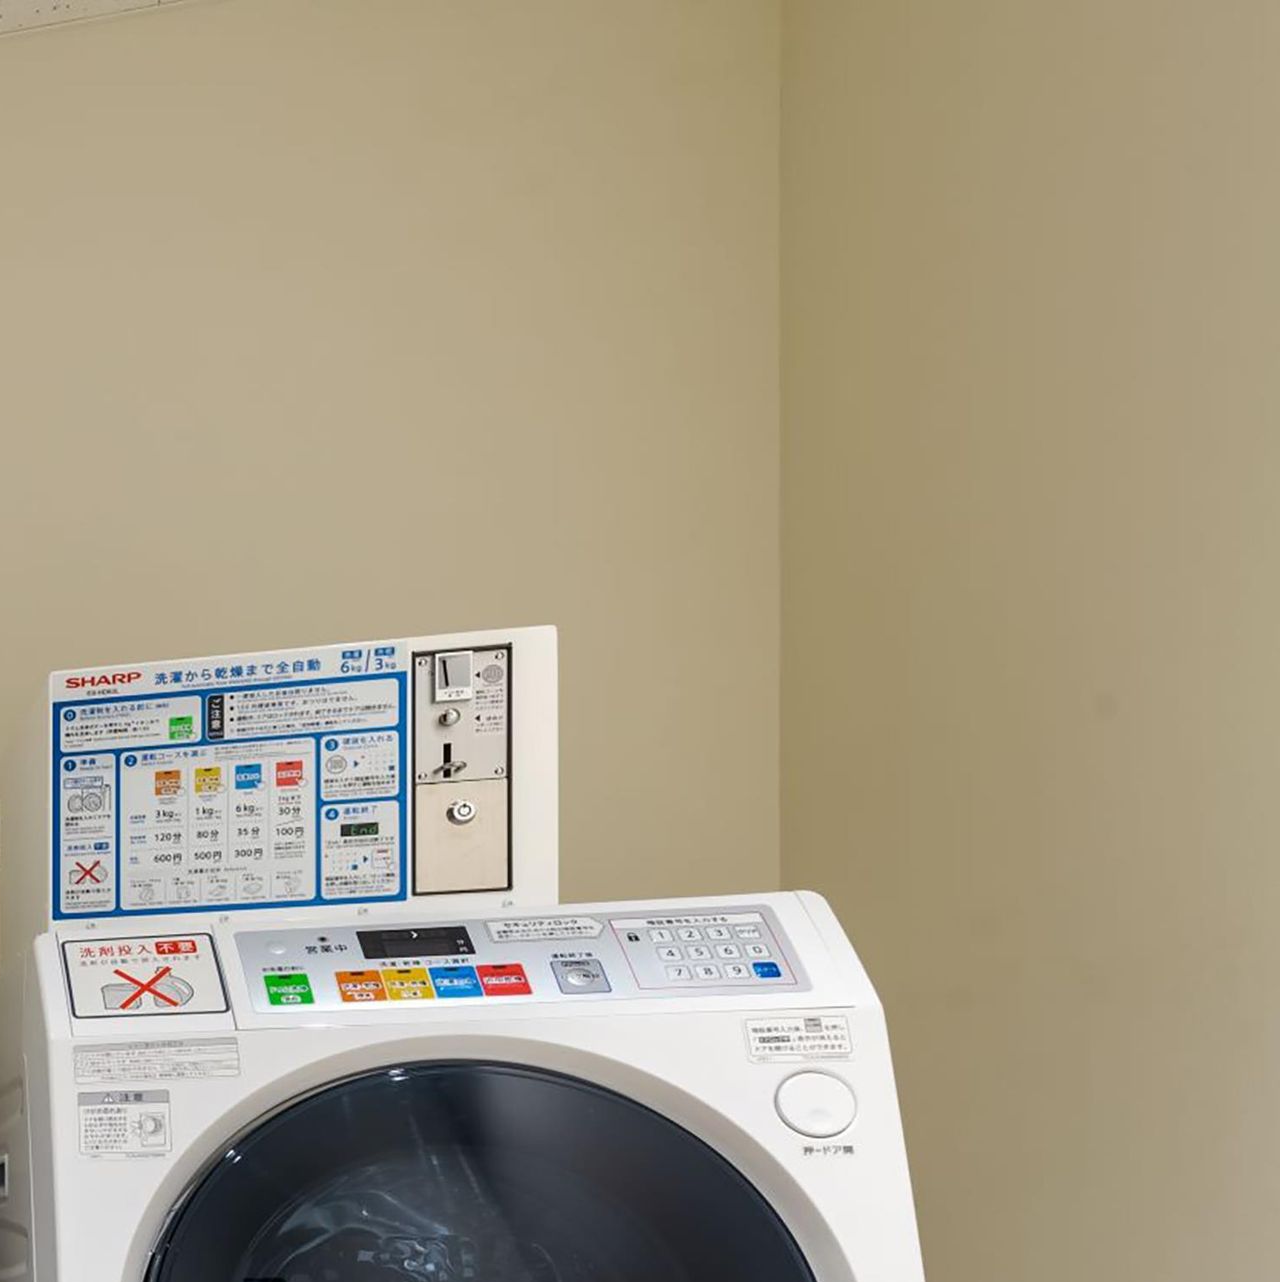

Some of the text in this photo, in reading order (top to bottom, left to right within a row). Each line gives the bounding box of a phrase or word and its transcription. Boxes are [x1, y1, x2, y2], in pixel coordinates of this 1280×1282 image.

[154, 659, 321, 686] 洗濯から乾燥まで全自動
[65, 672, 142, 689] SHARP
[657, 931, 665, 939] 1
[686, 930, 696, 939] 2
[716, 929, 724, 937] 3
[80, 944, 151, 959] 洗剤投入
[305, 943, 348, 955] 営業中
[666, 949, 675, 958] 4
[695, 948, 703, 957] 5
[724, 947, 733, 955] 6
[752, 946, 762, 955] 0
[675, 968, 683, 977] 7
[704, 968, 713, 976] 8
[732, 966, 741, 975] 9
